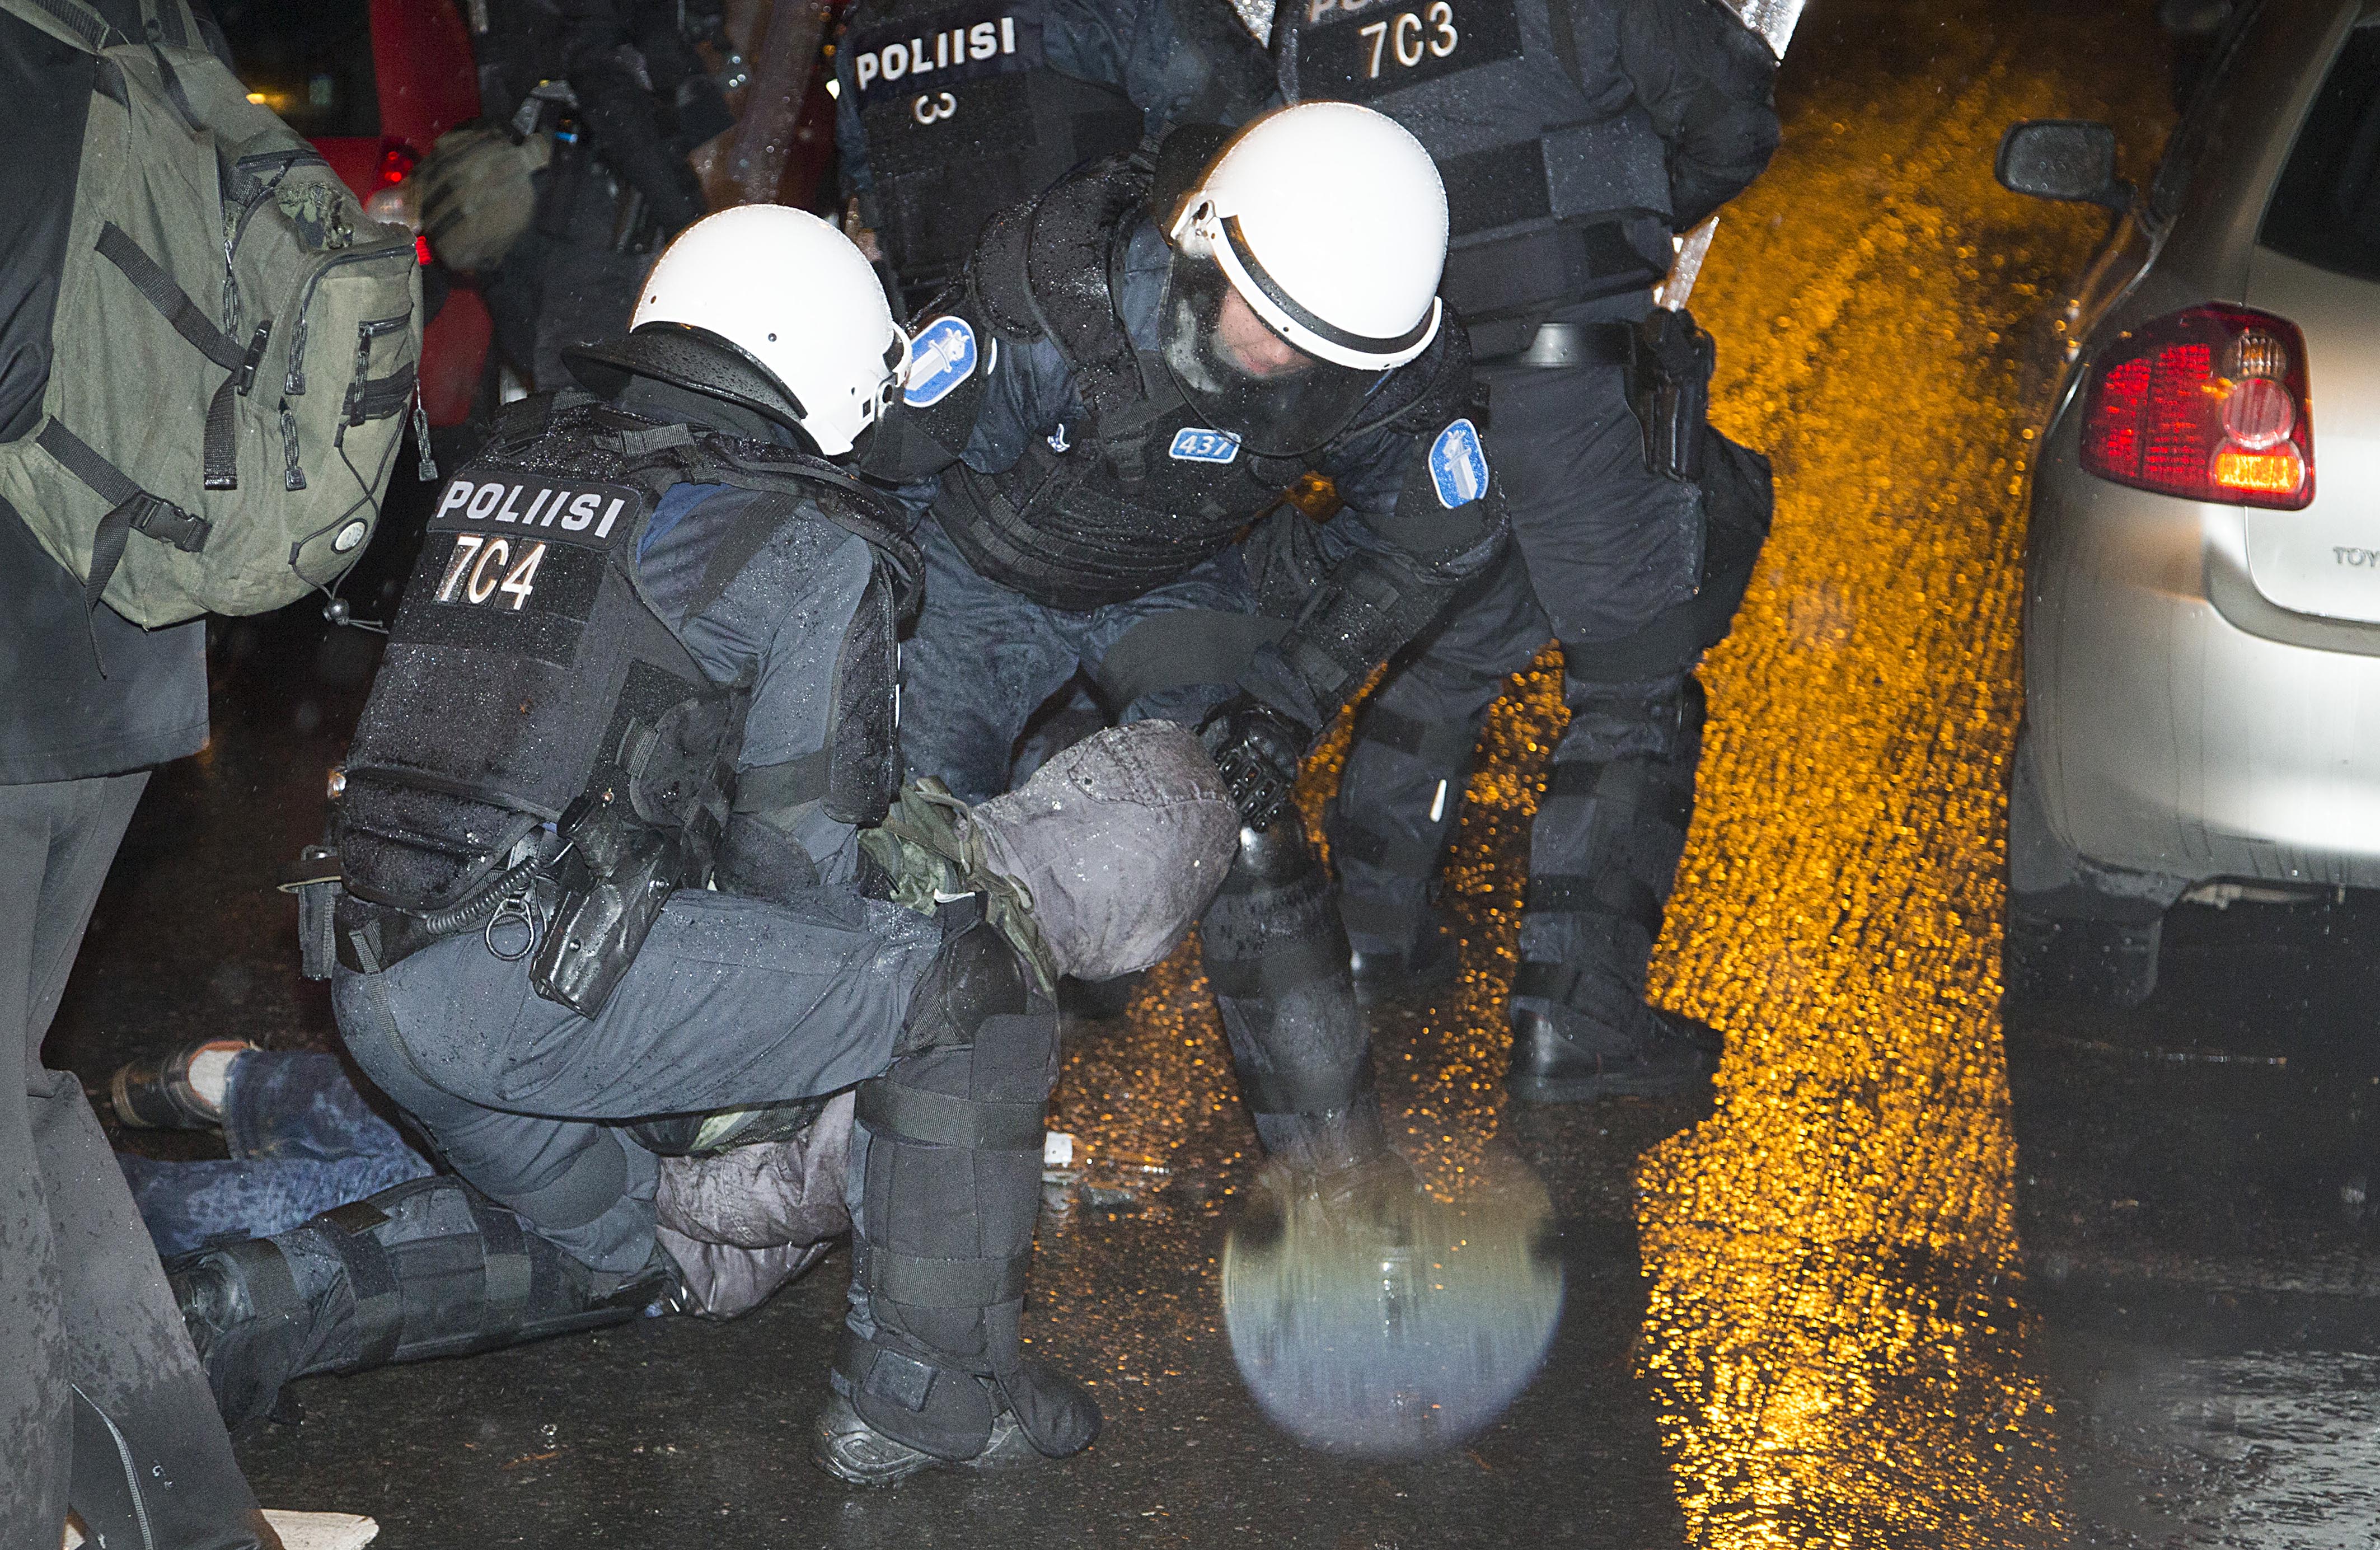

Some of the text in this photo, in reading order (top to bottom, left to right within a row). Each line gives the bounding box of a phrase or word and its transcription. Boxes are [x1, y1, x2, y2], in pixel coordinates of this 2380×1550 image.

[856, 17, 1016, 90] POLIISI
[1360, 1, 1458, 78] 7C3
[1178, 435, 1231, 456] 437
[436, 480, 625, 538] POLIISI
[439, 536, 546, 611] 7C4
